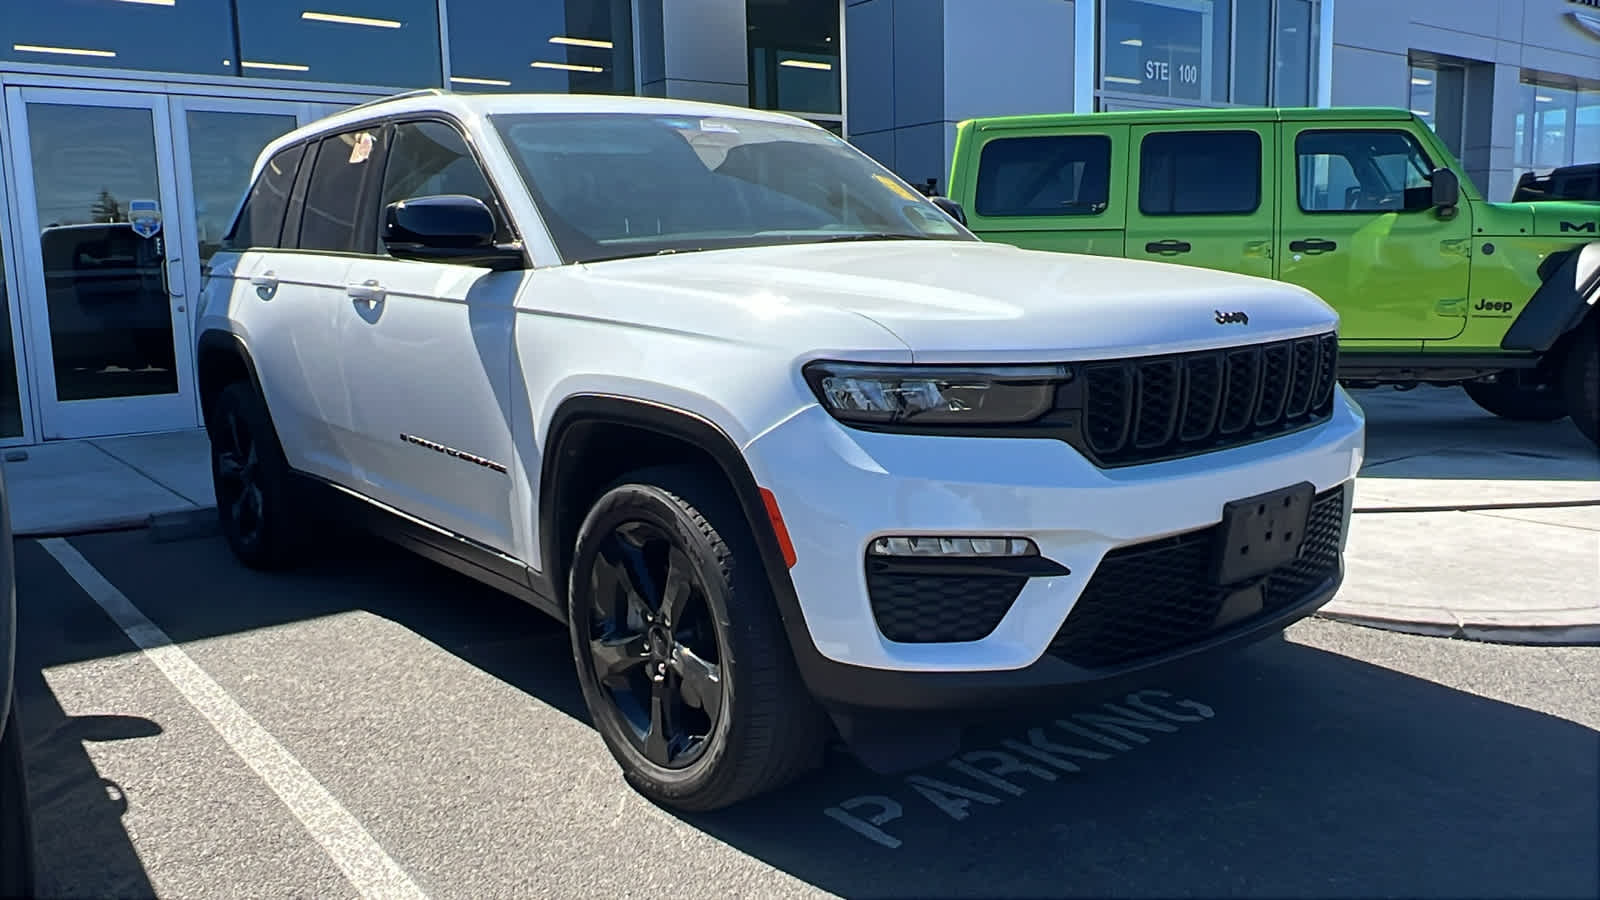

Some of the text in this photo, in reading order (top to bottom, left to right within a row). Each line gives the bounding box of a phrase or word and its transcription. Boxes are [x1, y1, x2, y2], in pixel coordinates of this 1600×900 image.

[1145, 60, 1197, 84] STE 100
[1560, 221, 1600, 233] M
[1474, 298, 1513, 313] Jeep
[824, 690, 1215, 849] PARKING
